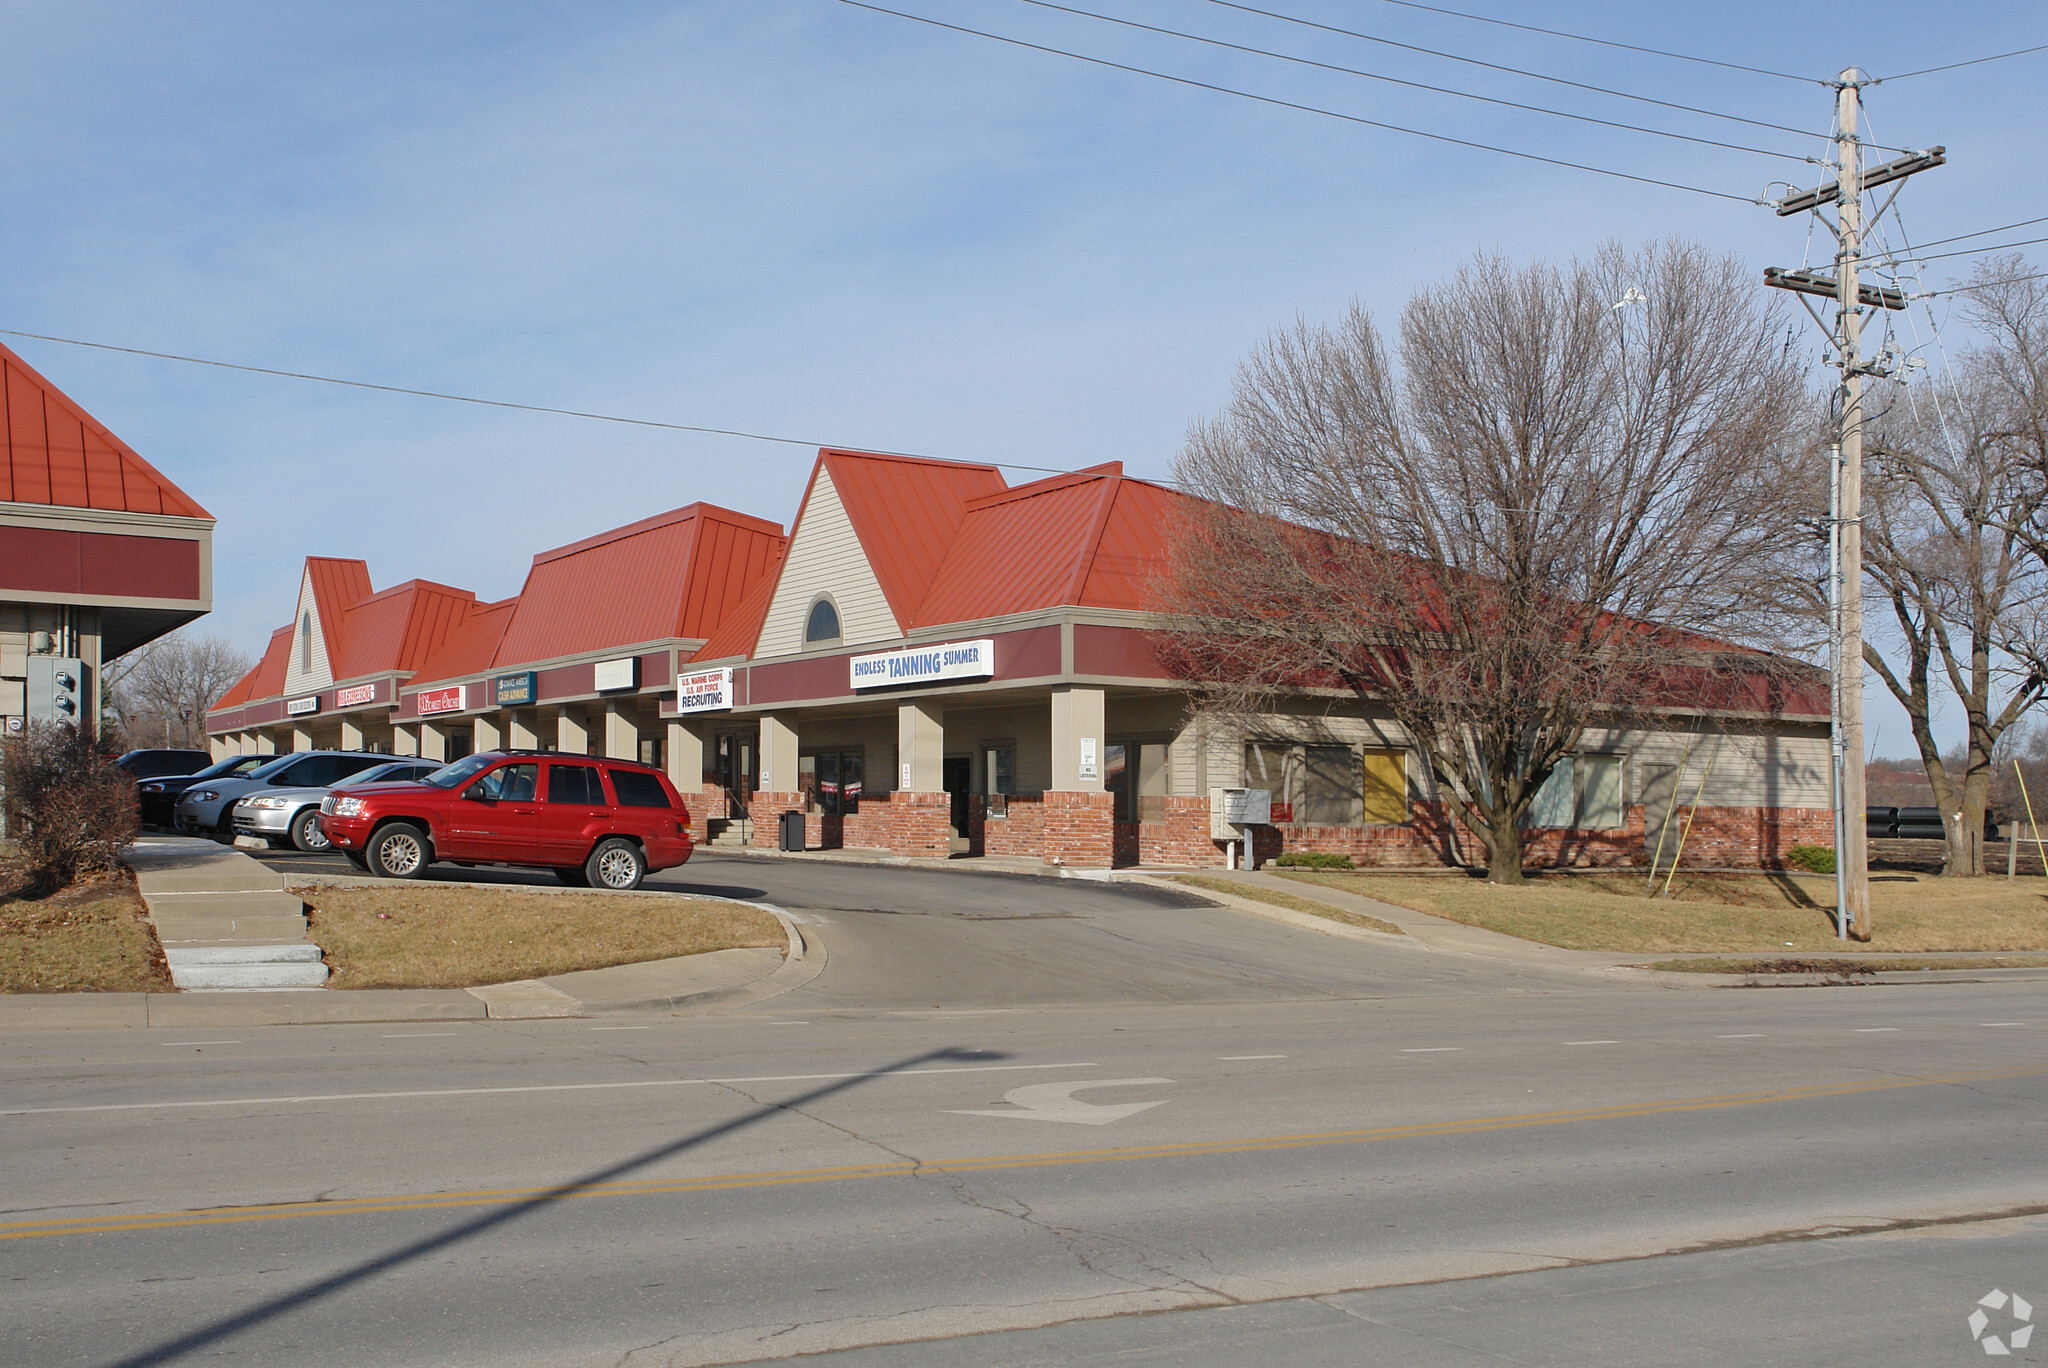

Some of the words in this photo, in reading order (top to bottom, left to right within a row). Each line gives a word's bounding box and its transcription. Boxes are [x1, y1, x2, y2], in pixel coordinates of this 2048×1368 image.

[854, 659, 886, 677] ENDLESS
[888, 652, 941, 678] TANNING
[943, 647, 979, 666] SUMMER
[681, 678, 690, 686] U.S.
[691, 675, 707, 685] MARINE
[708, 672, 723, 682] CORPS
[498, 690, 509, 702] CASH
[509, 687, 528, 700] ADVANCE
[686, 686, 695, 695] U.S.
[696, 685, 704, 693] AIR
[704, 683, 719, 692] FORCE
[682, 691, 723, 708] RECRUITING
